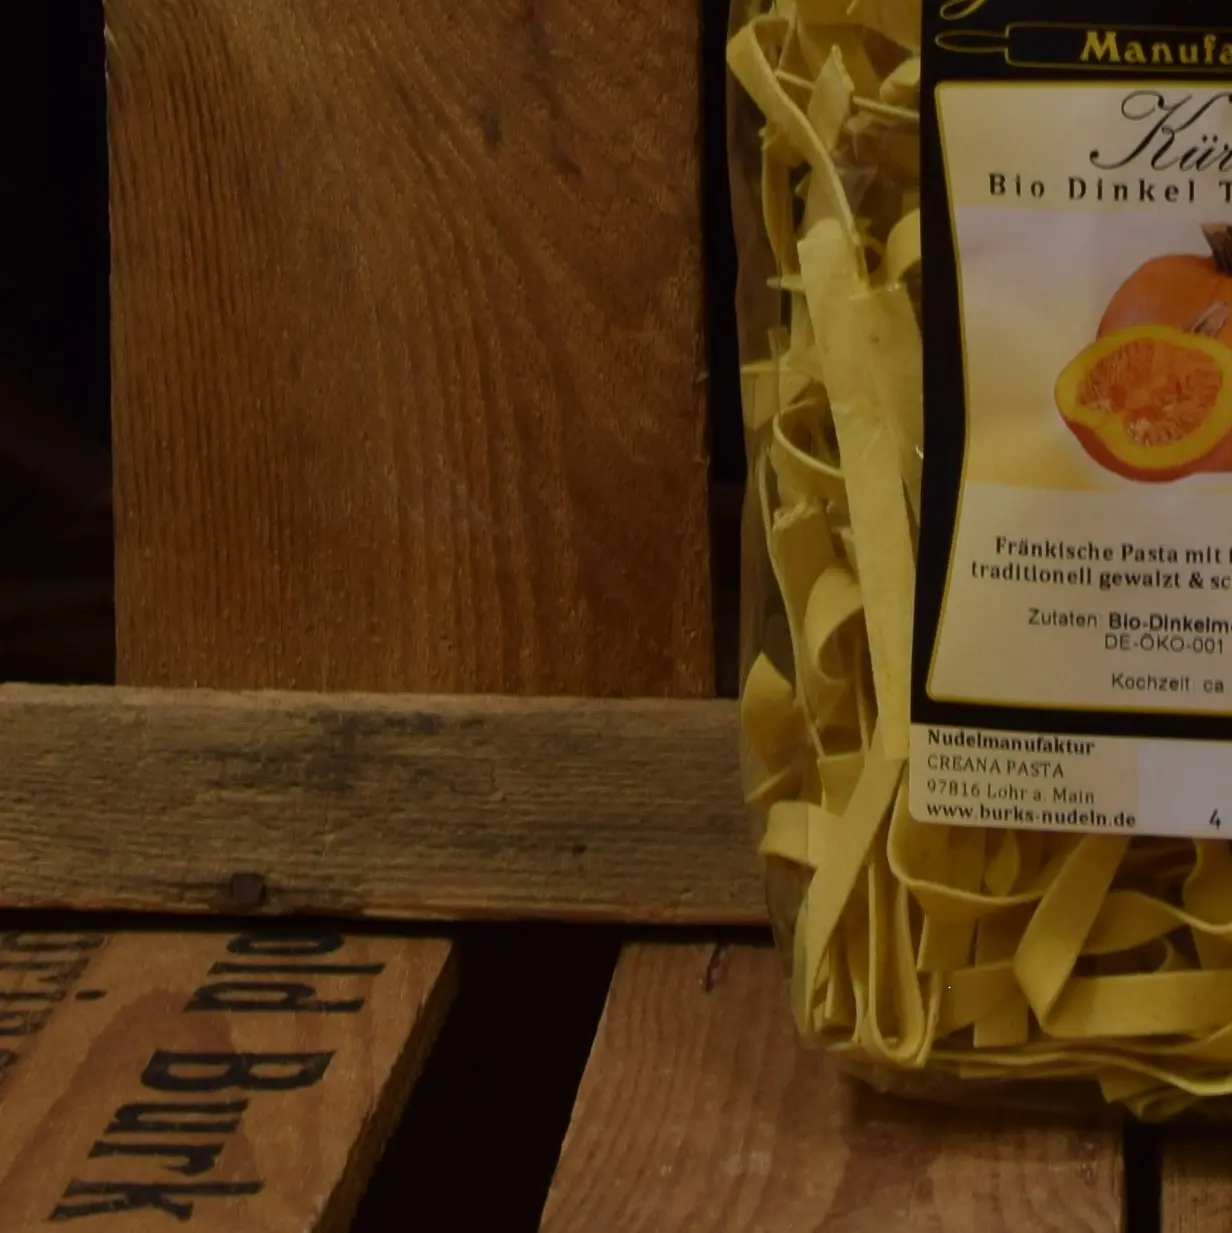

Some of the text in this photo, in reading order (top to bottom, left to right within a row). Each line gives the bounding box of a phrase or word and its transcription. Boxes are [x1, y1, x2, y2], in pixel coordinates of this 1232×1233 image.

[988, 173, 1045, 198] Bio
[1068, 176, 1196, 203] Dinkel
[996, 536, 1113, 561] Fränkische
[1121, 543, 1178, 563] Pasta
[1185, 544, 1220, 565] mit
[971, 561, 1092, 585] traditionell
[1099, 569, 1181, 590] gewalzt
[1188, 571, 1204, 589] &
[1104, 633, 1223, 654] DE-ÖKO-001
[928, 729, 1095, 755] Nudelmanufaktur
[928, 753, 1064, 779] CREANA PASTA
[928, 780, 980, 798] 97816
[987, 783, 1027, 801] Lohr
[1053, 788, 1095, 805] Main
[927, 804, 1136, 828] www.burks-nudeln.de
[1209, 810, 1221, 830] 4
[49, 1051, 336, 1221] Burk
